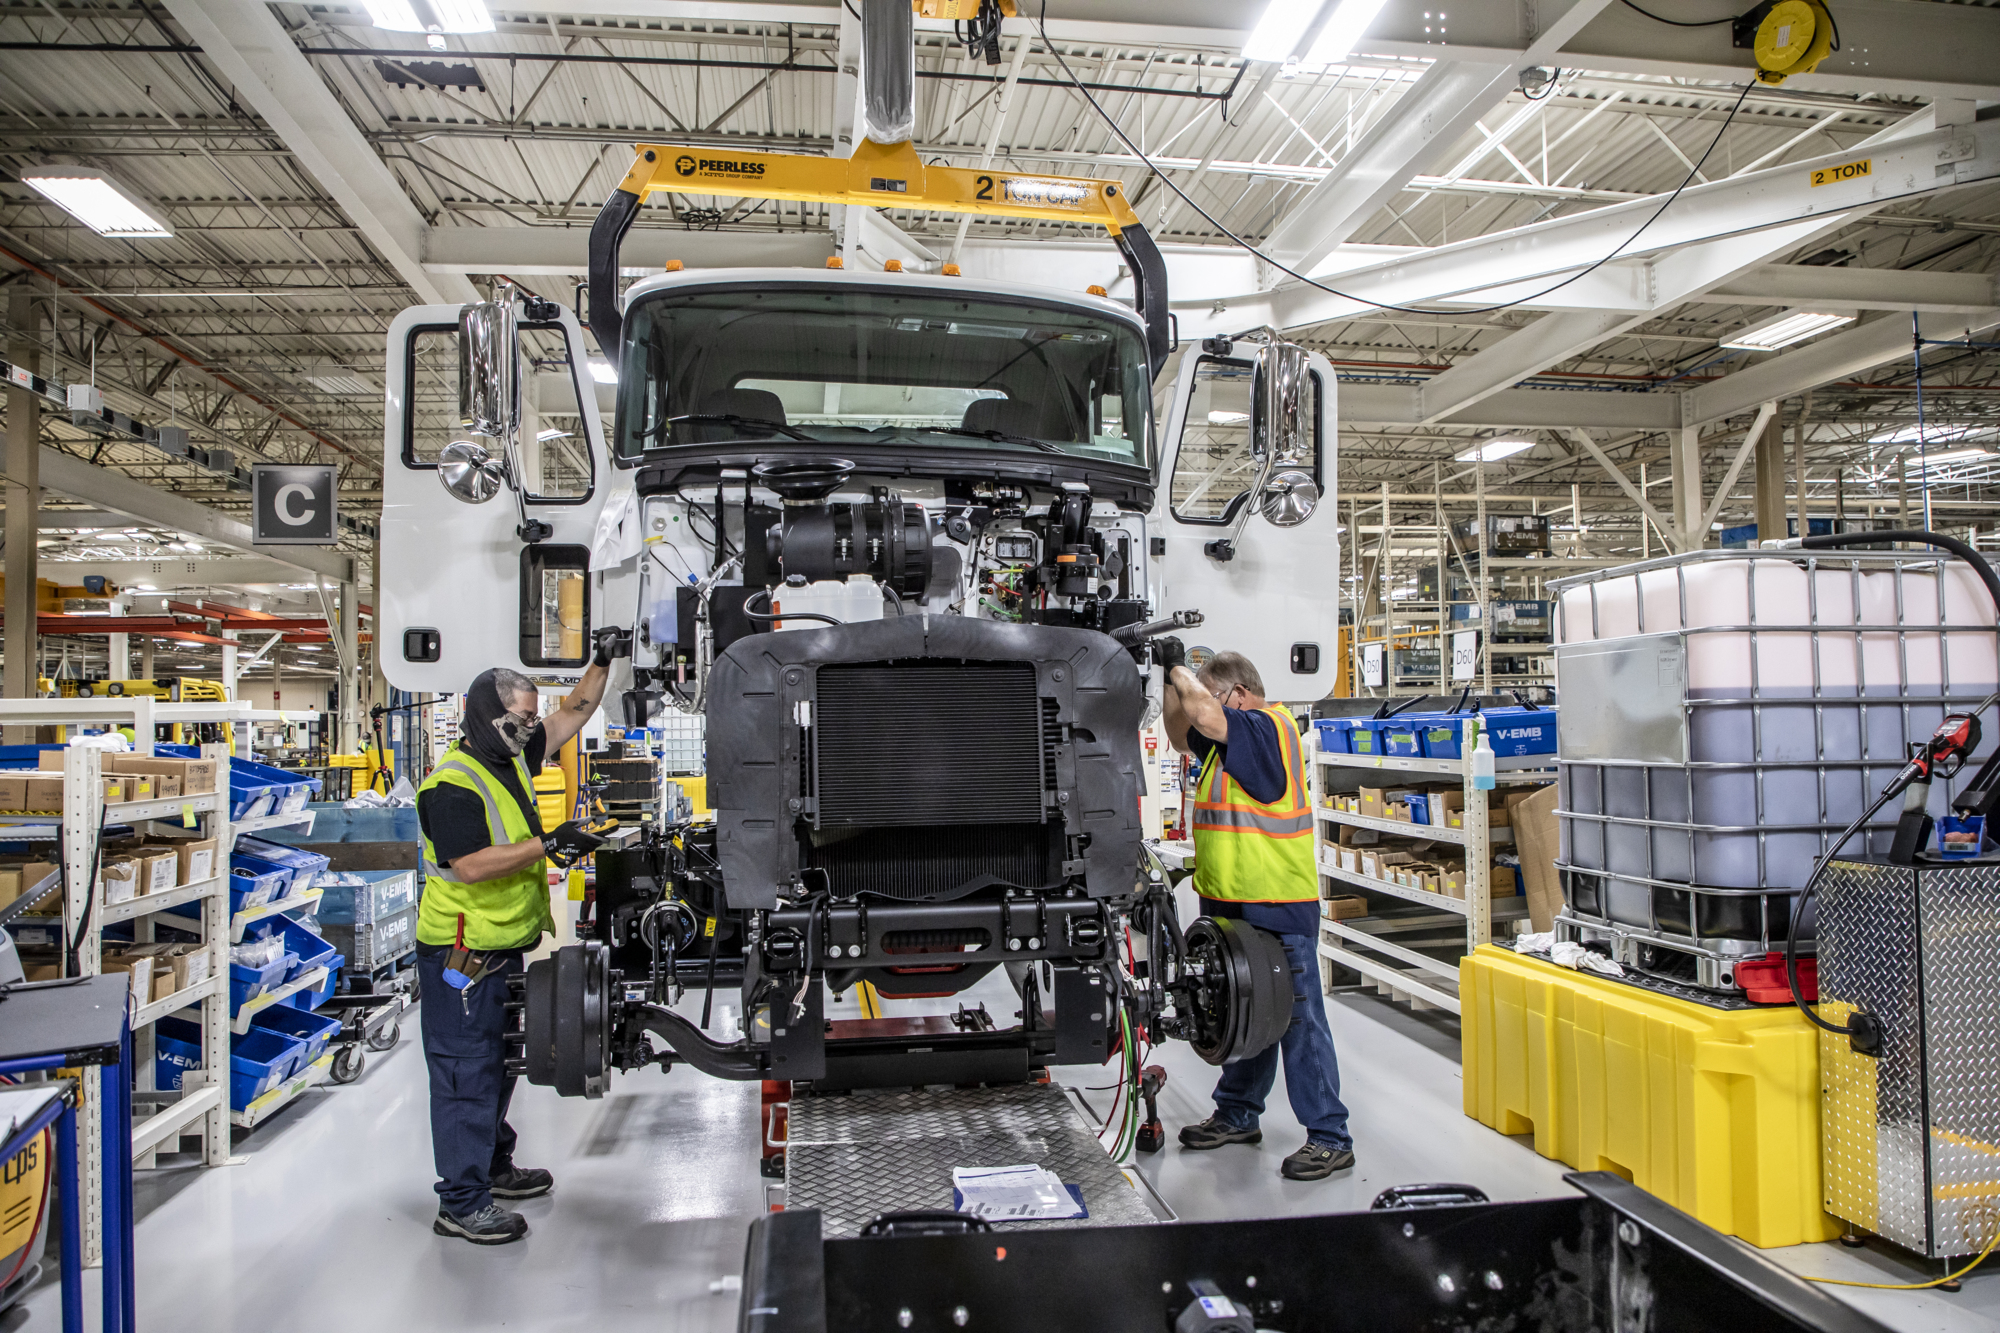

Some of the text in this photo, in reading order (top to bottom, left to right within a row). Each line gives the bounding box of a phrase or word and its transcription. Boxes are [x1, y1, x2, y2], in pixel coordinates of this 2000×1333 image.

[699, 159, 766, 175] PEERLESS
[1815, 161, 1868, 184] 2 TON
[976, 176, 993, 200] 2
[274, 483, 316, 527] C
[1366, 659, 1380, 673] D50
[1456, 648, 1473, 665] D60
[1497, 726, 1542, 740] V-EMB
[380, 916, 408, 941] V-EMB
[157, 1049, 202, 1071] V-EM
